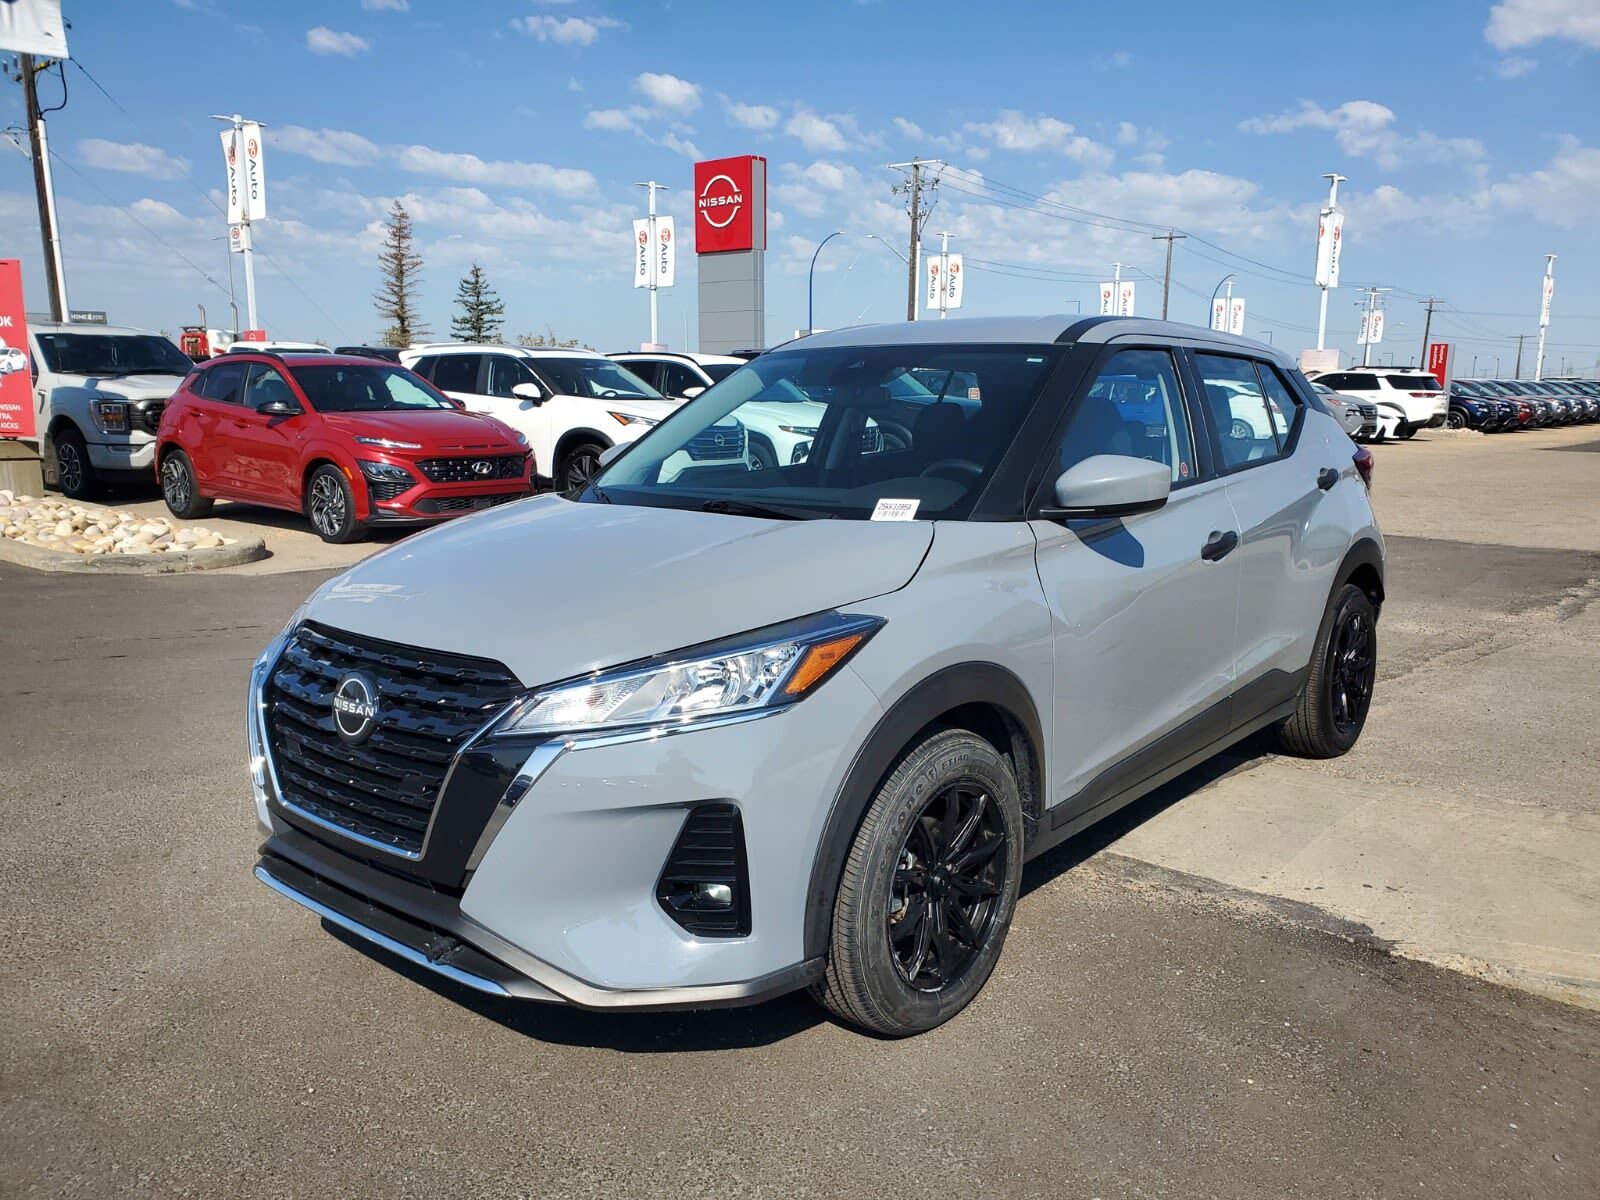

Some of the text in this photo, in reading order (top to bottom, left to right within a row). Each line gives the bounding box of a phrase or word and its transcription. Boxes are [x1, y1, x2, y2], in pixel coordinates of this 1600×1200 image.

[249, 159, 258, 200] Auto
[698, 194, 743, 208] NISSAN
[333, 696, 375, 717] NISSAN
[941, 753, 969, 771] FT140
